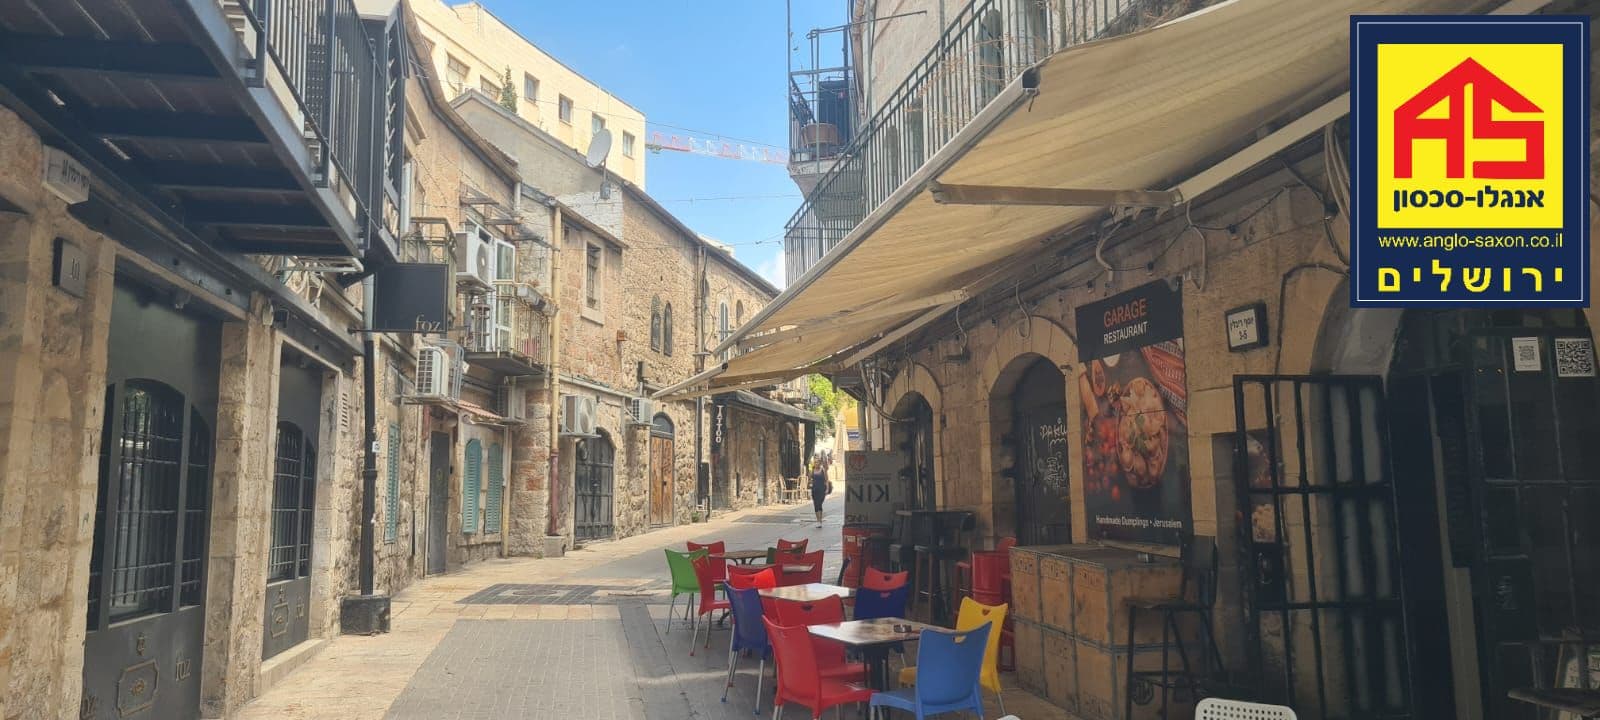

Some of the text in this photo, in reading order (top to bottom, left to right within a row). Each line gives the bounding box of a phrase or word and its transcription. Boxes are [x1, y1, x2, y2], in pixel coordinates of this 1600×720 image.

[1104, 298, 1147, 327] GARAGE
[1104, 321, 1148, 344] RESTAURANT
[716, 405, 724, 443] TATTOO
[1096, 514, 1182, 528] Handmade Dumplings Jerusalem
